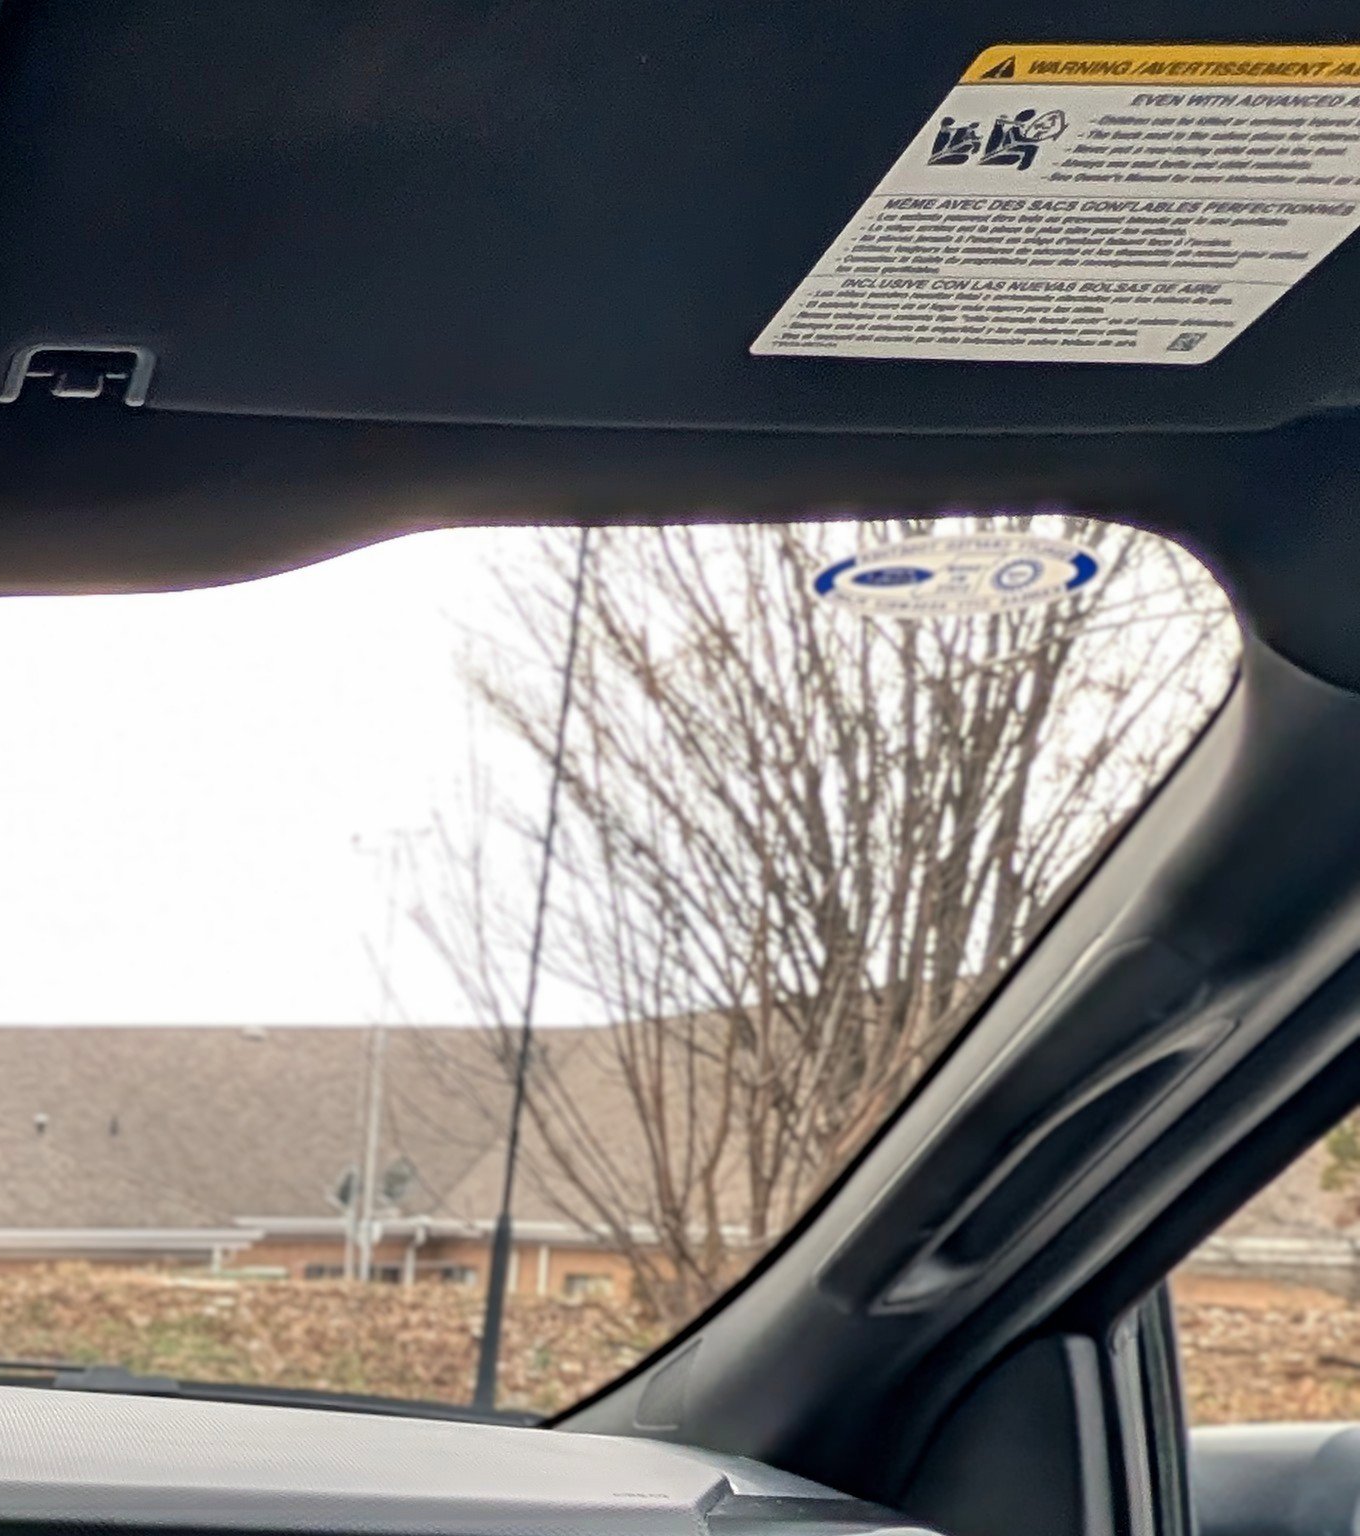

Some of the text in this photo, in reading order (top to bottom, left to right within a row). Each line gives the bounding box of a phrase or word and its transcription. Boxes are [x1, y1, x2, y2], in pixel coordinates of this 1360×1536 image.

[1028, 60, 1132, 75] WARNING
[1130, 93, 1185, 107] EVEN
[1186, 94, 1238, 107] WITH
[1235, 94, 1346, 107] ADVANCED
[939, 199, 988, 210] AVEC
[987, 200, 1027, 211] DES
[1027, 200, 1080, 212] SACS
[1080, 201, 1202, 213] GONFLABLES
[841, 278, 1221, 294] INCLUSIVE CON LAS NUEVAS BOLSAS DE AIRE
